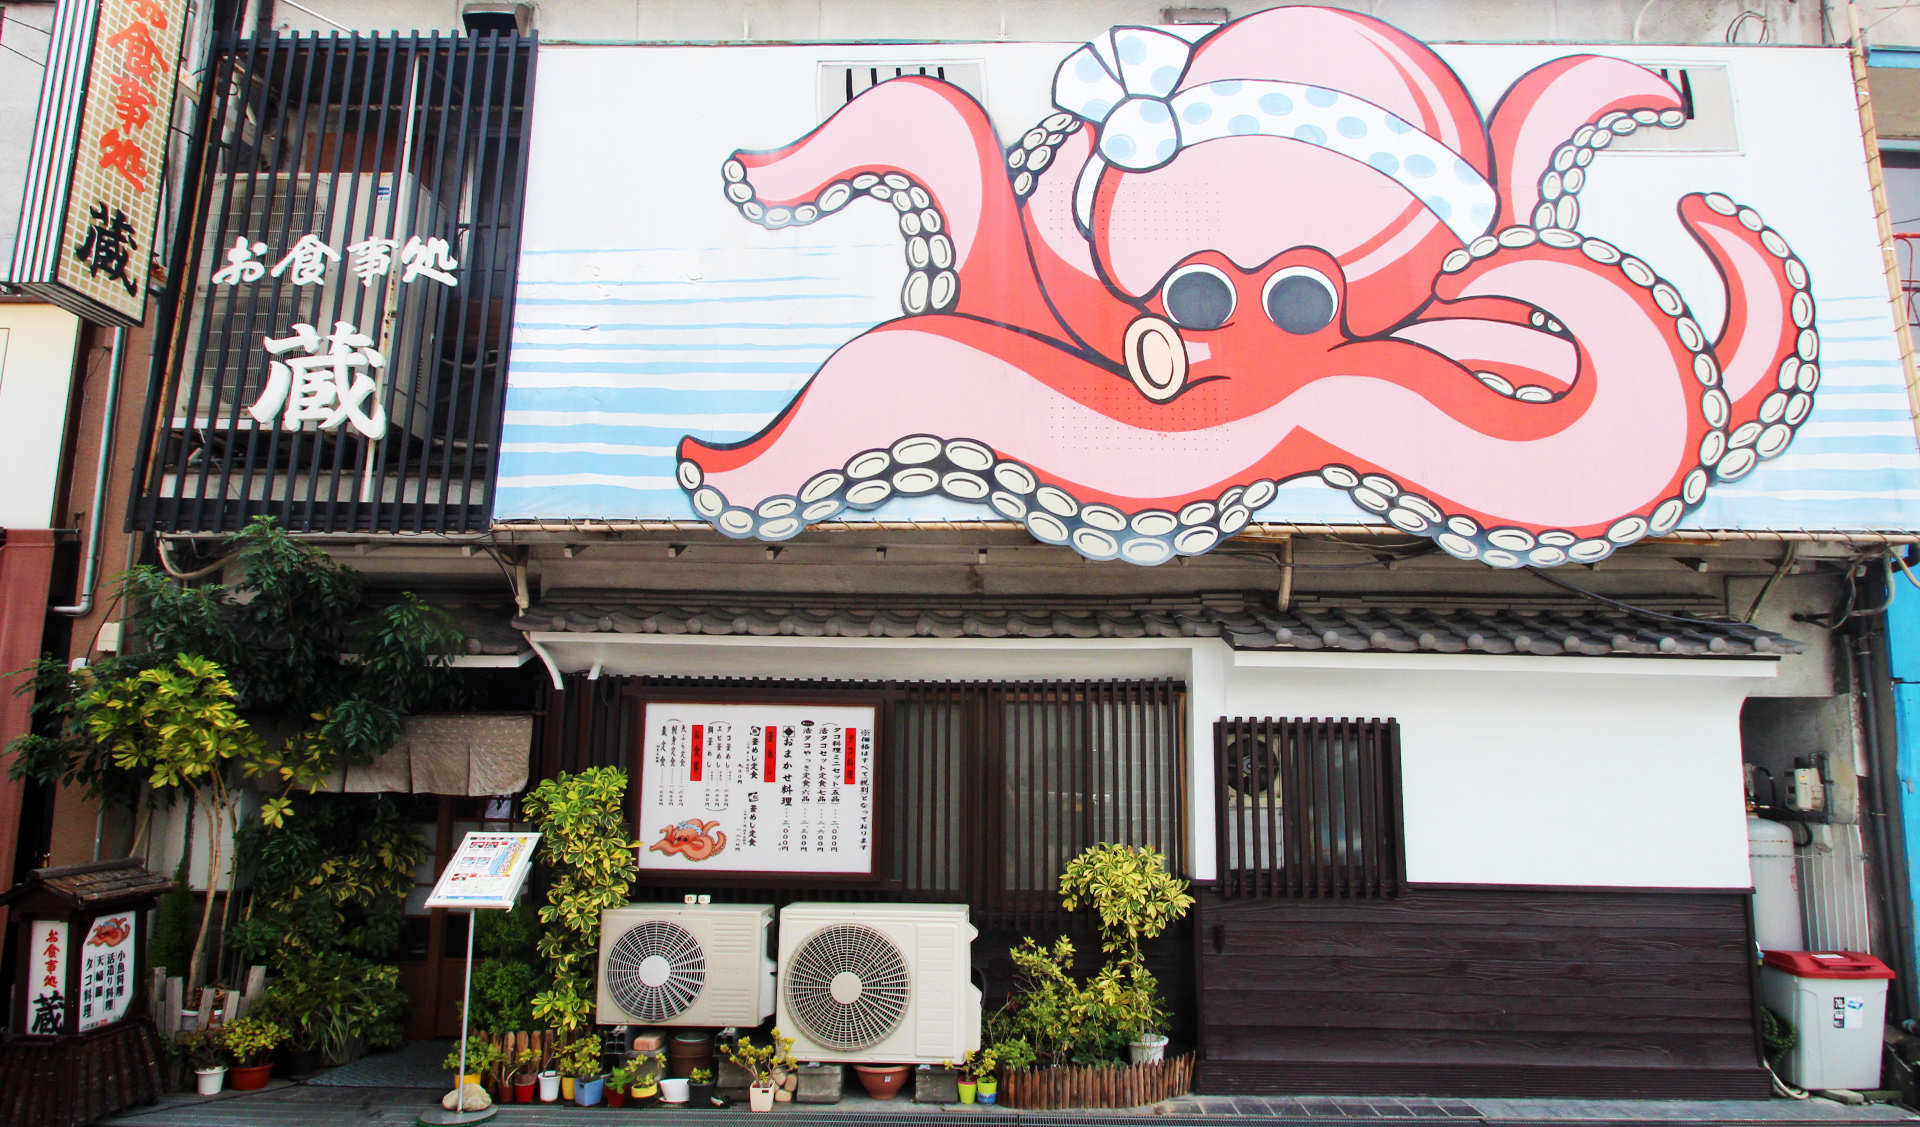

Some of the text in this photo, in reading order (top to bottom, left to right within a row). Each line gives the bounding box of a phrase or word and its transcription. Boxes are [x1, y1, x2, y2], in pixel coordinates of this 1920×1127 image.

[75, 201, 139, 298] 蔵
[211, 234, 459, 287] お食事処
[248, 321, 387, 440] 蔵
[781, 737, 793, 806] おまかせ料理
[43, 929, 60, 988] お食事処
[83, 957, 93, 1018] タコ料理
[116, 950, 125, 997] 小魚料理
[31, 990, 66, 1034] 蔵
